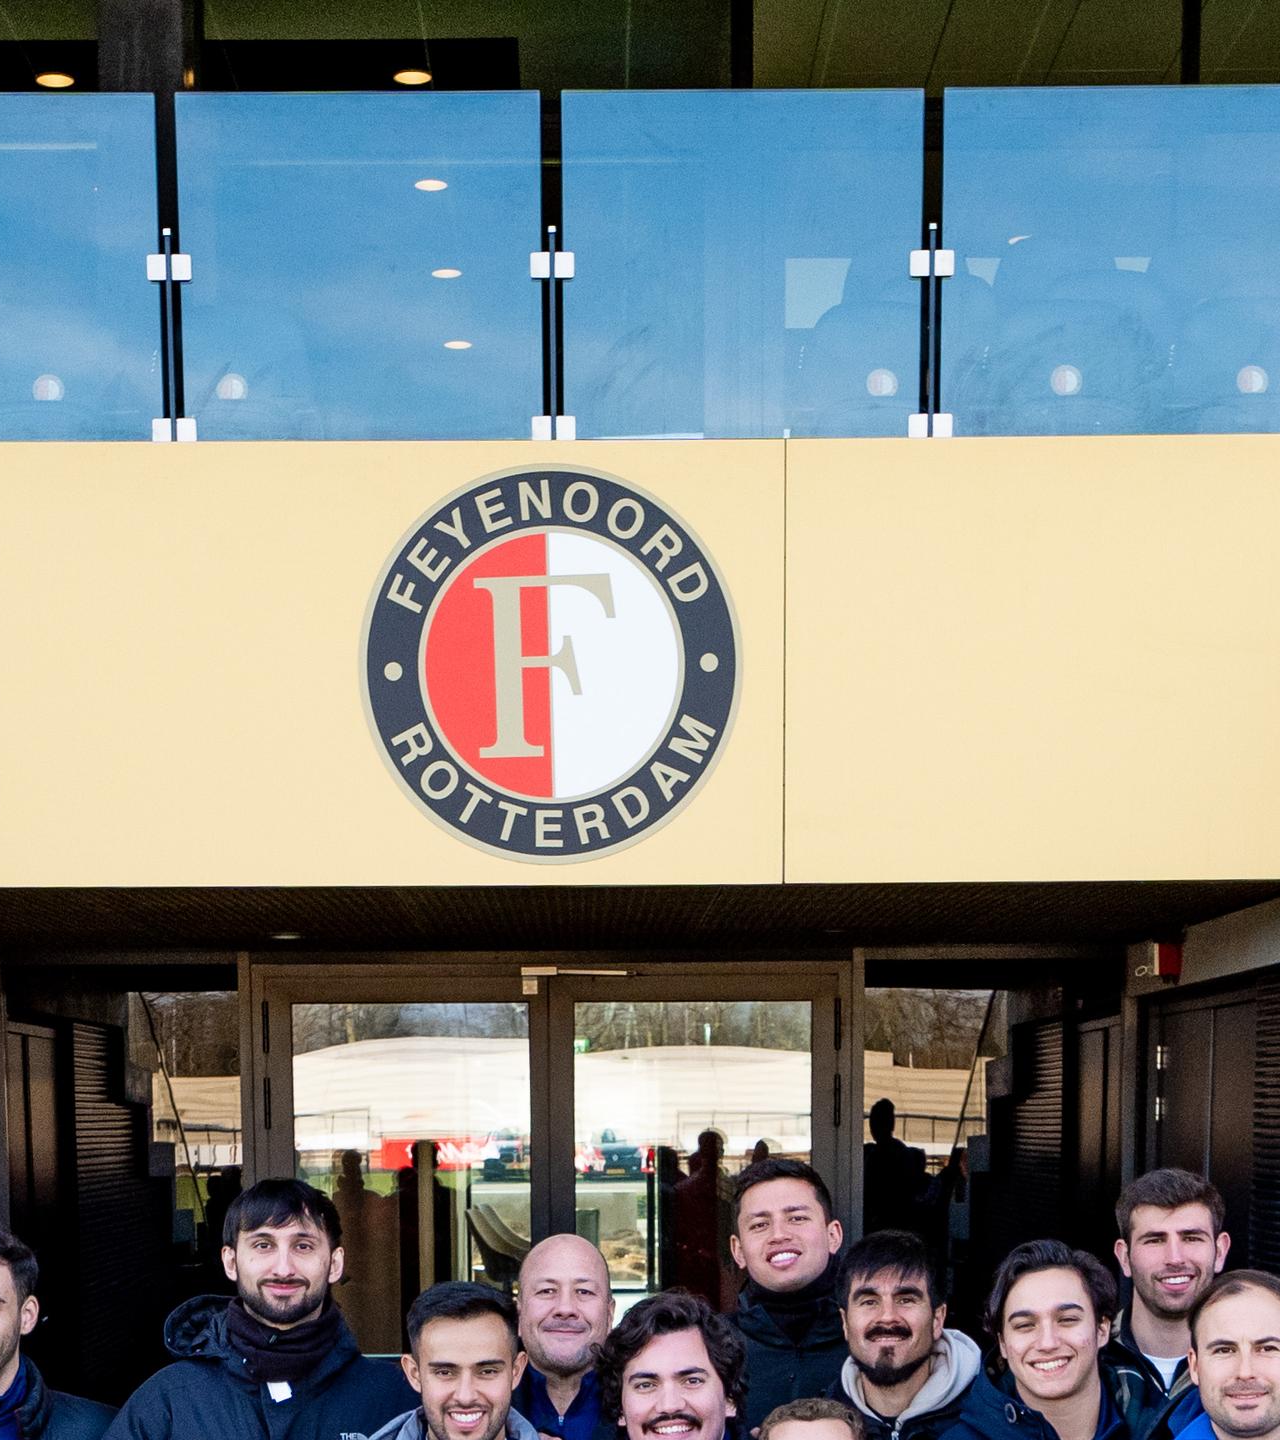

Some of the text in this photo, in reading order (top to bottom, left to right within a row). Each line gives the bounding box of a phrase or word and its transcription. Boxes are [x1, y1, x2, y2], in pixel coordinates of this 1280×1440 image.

[387, 479, 710, 614] FEYENOORD
[473, 573, 617, 759] F
[391, 714, 717, 848] ROTTERDAM
[340, 1433, 357, 1440] THE
